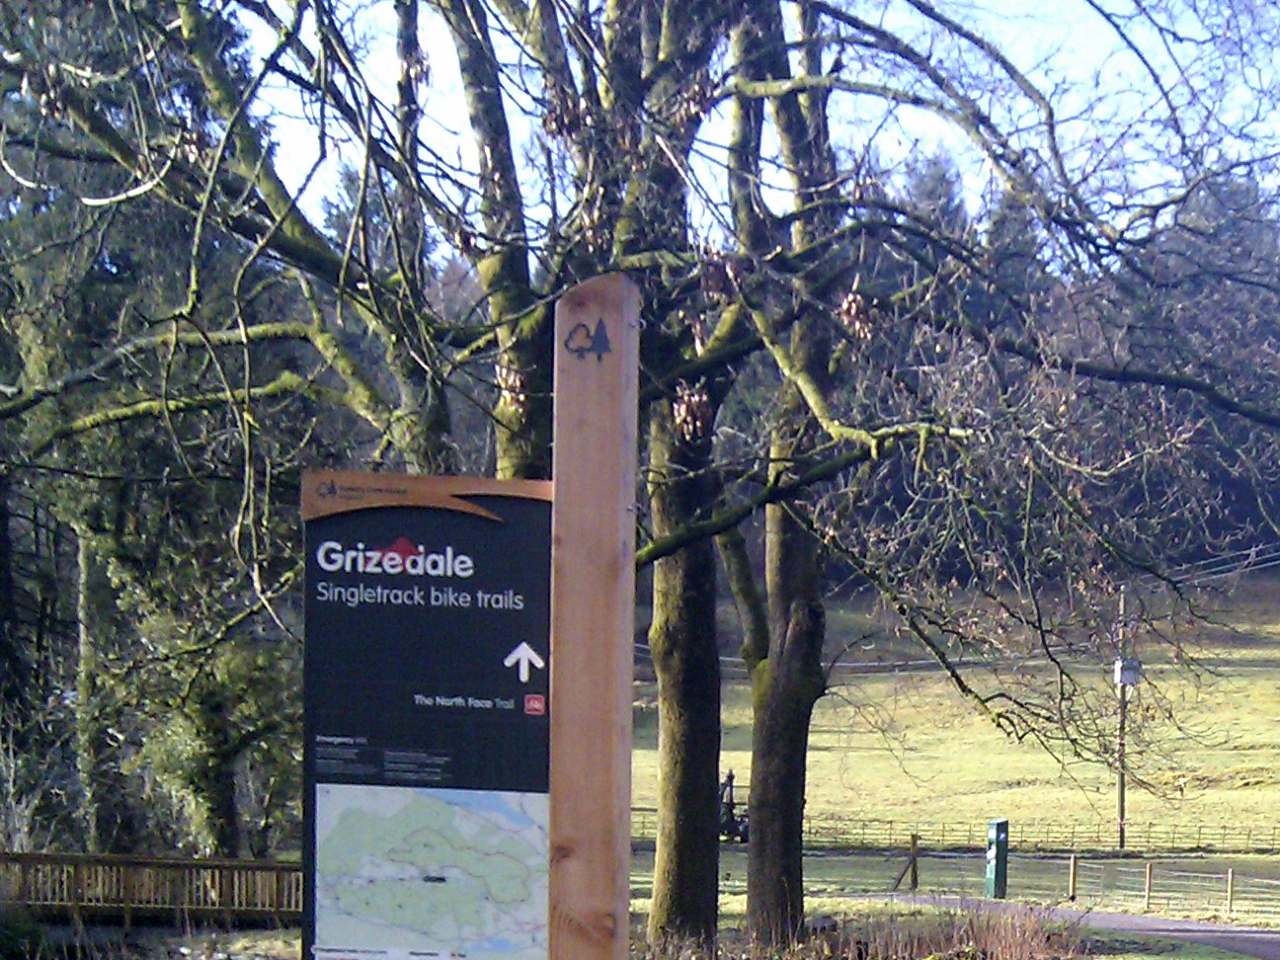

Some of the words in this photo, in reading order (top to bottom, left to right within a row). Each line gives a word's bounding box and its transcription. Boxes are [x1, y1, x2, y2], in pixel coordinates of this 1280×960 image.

[316, 540, 474, 578] Grizedale
[316, 582, 425, 607] Singletrack
[430, 585, 471, 607] bike
[477, 588, 524, 610] trails
[413, 694, 434, 706] The
[435, 695, 466, 707] North
[468, 697, 493, 709] Face
[494, 698, 515, 709] Trail
